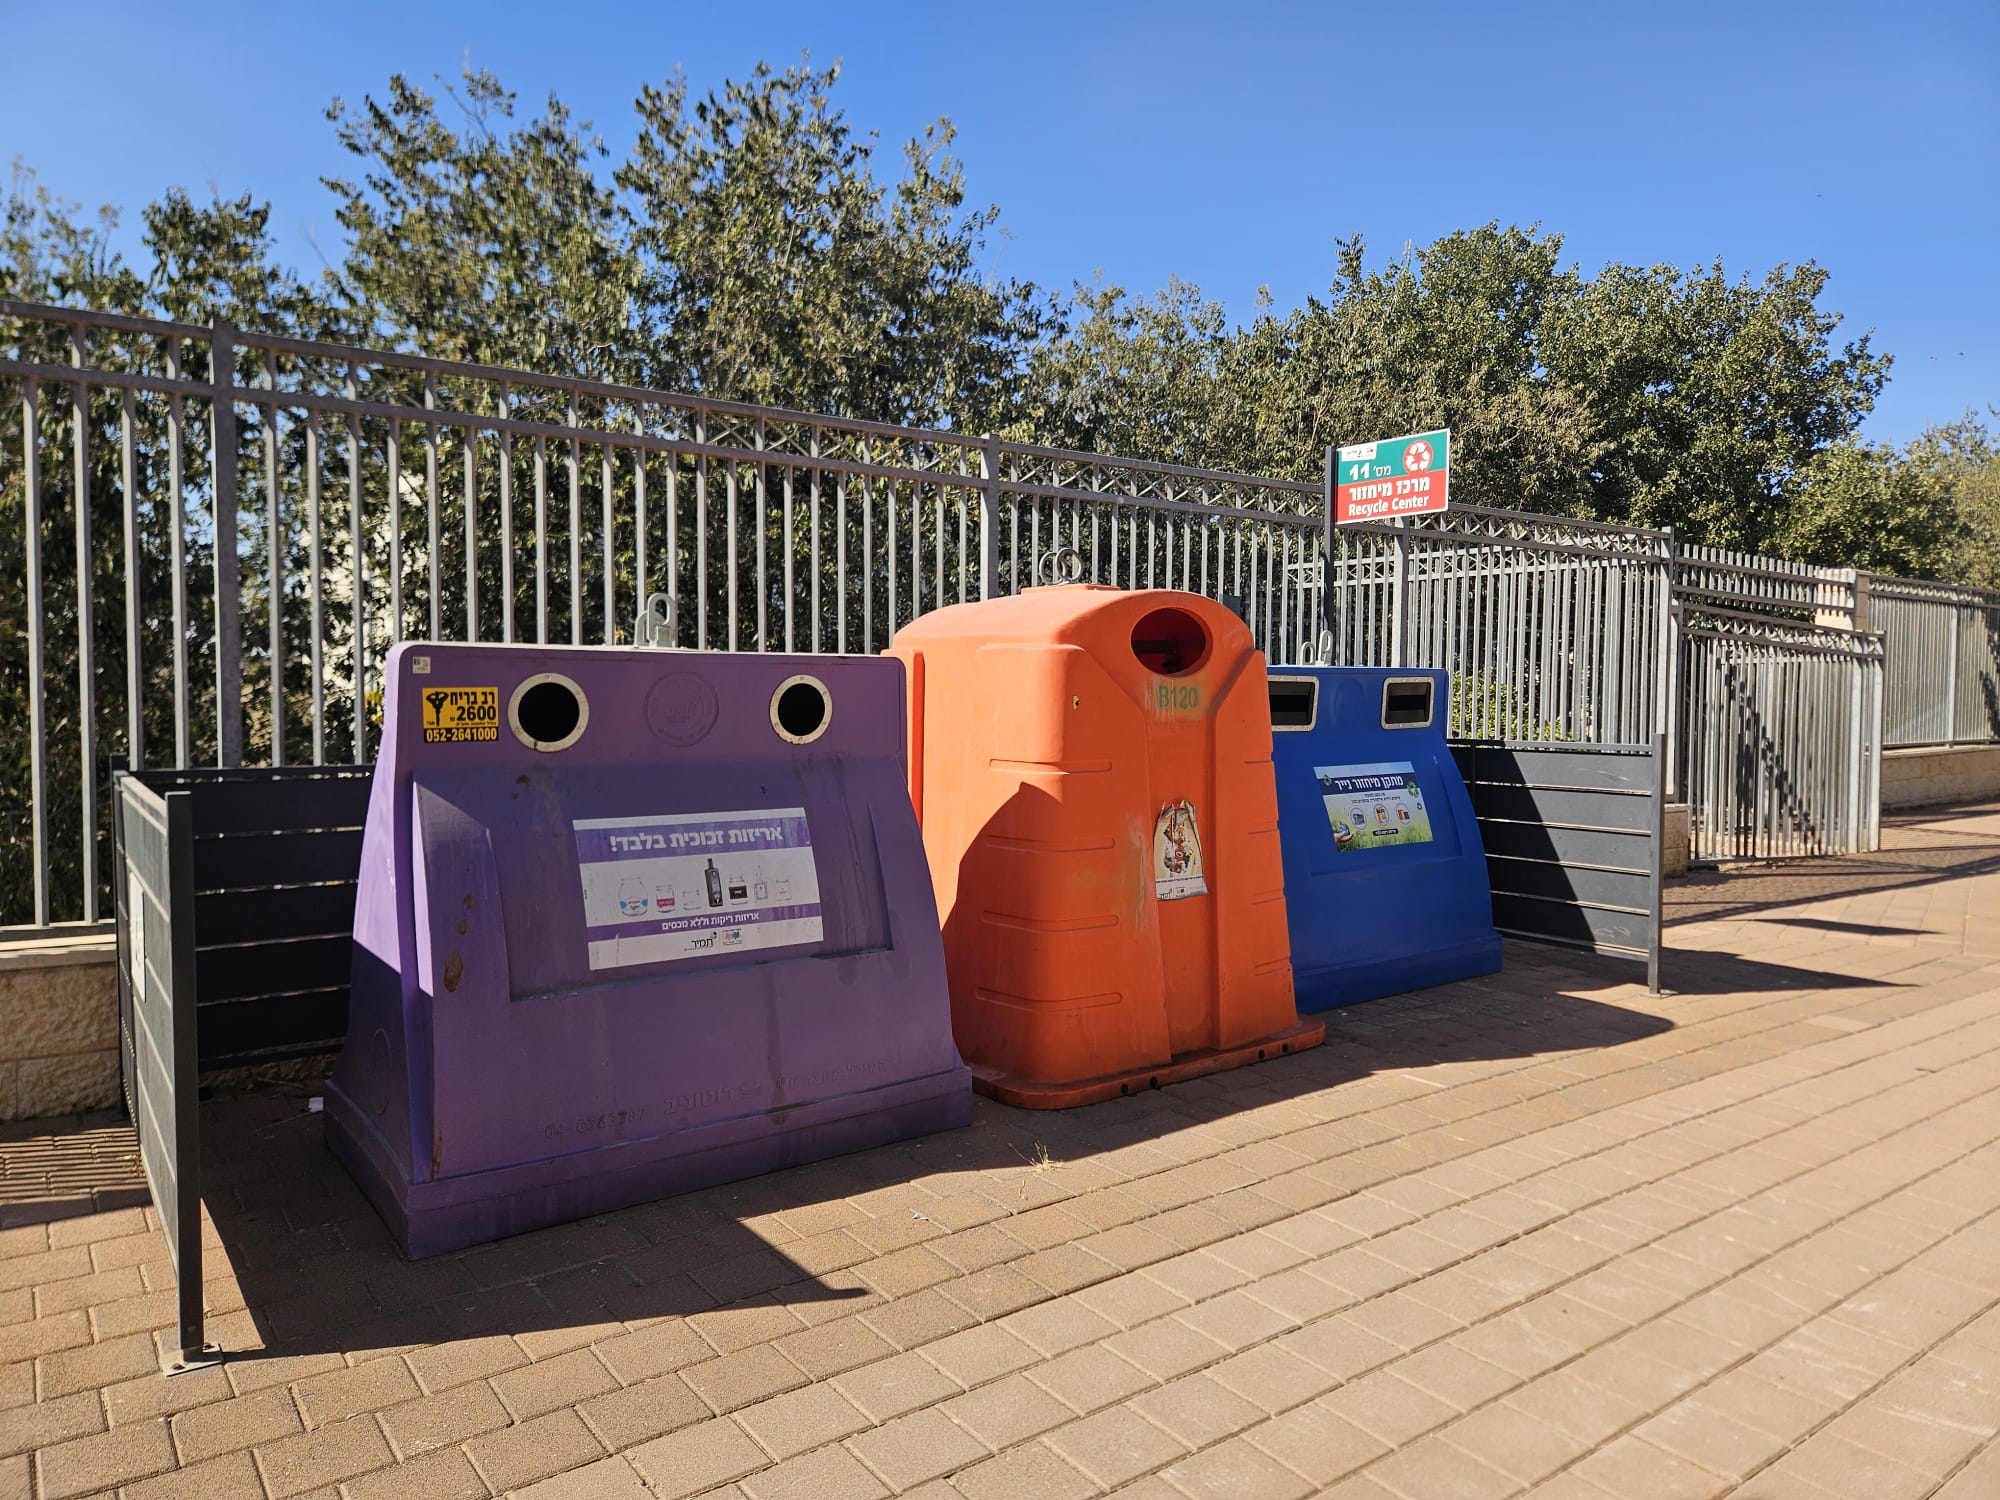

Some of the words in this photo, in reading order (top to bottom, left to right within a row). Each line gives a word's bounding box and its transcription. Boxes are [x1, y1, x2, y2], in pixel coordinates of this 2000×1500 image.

[1349, 462, 1370, 480] 11
[1349, 481, 1392, 501] מיחזור
[1396, 476, 1430, 495] מרכז
[1348, 499, 1388, 517] Recycle
[1392, 495, 1429, 511] Center
[450, 691, 478, 705] בריח
[481, 691, 495, 704] רב
[1158, 684, 1199, 708] B120
[456, 705, 496, 721] 2600
[426, 728, 497, 742] 052-2641000
[1334, 779, 1352, 790] נייר
[1352, 777, 1381, 789] מיחזור
[1381, 775, 1403, 789] מתקן
[610, 833, 666, 851] בלבד!
[669, 830, 724, 848] זכוכית
[727, 826, 783, 844] אריזות
[690, 917, 710, 928] וללא
[711, 916, 734, 926] ריקות
[734, 912, 760, 922] אריזות
[661, 920, 688, 930] מכסים
[691, 938, 713, 949] תמיר
